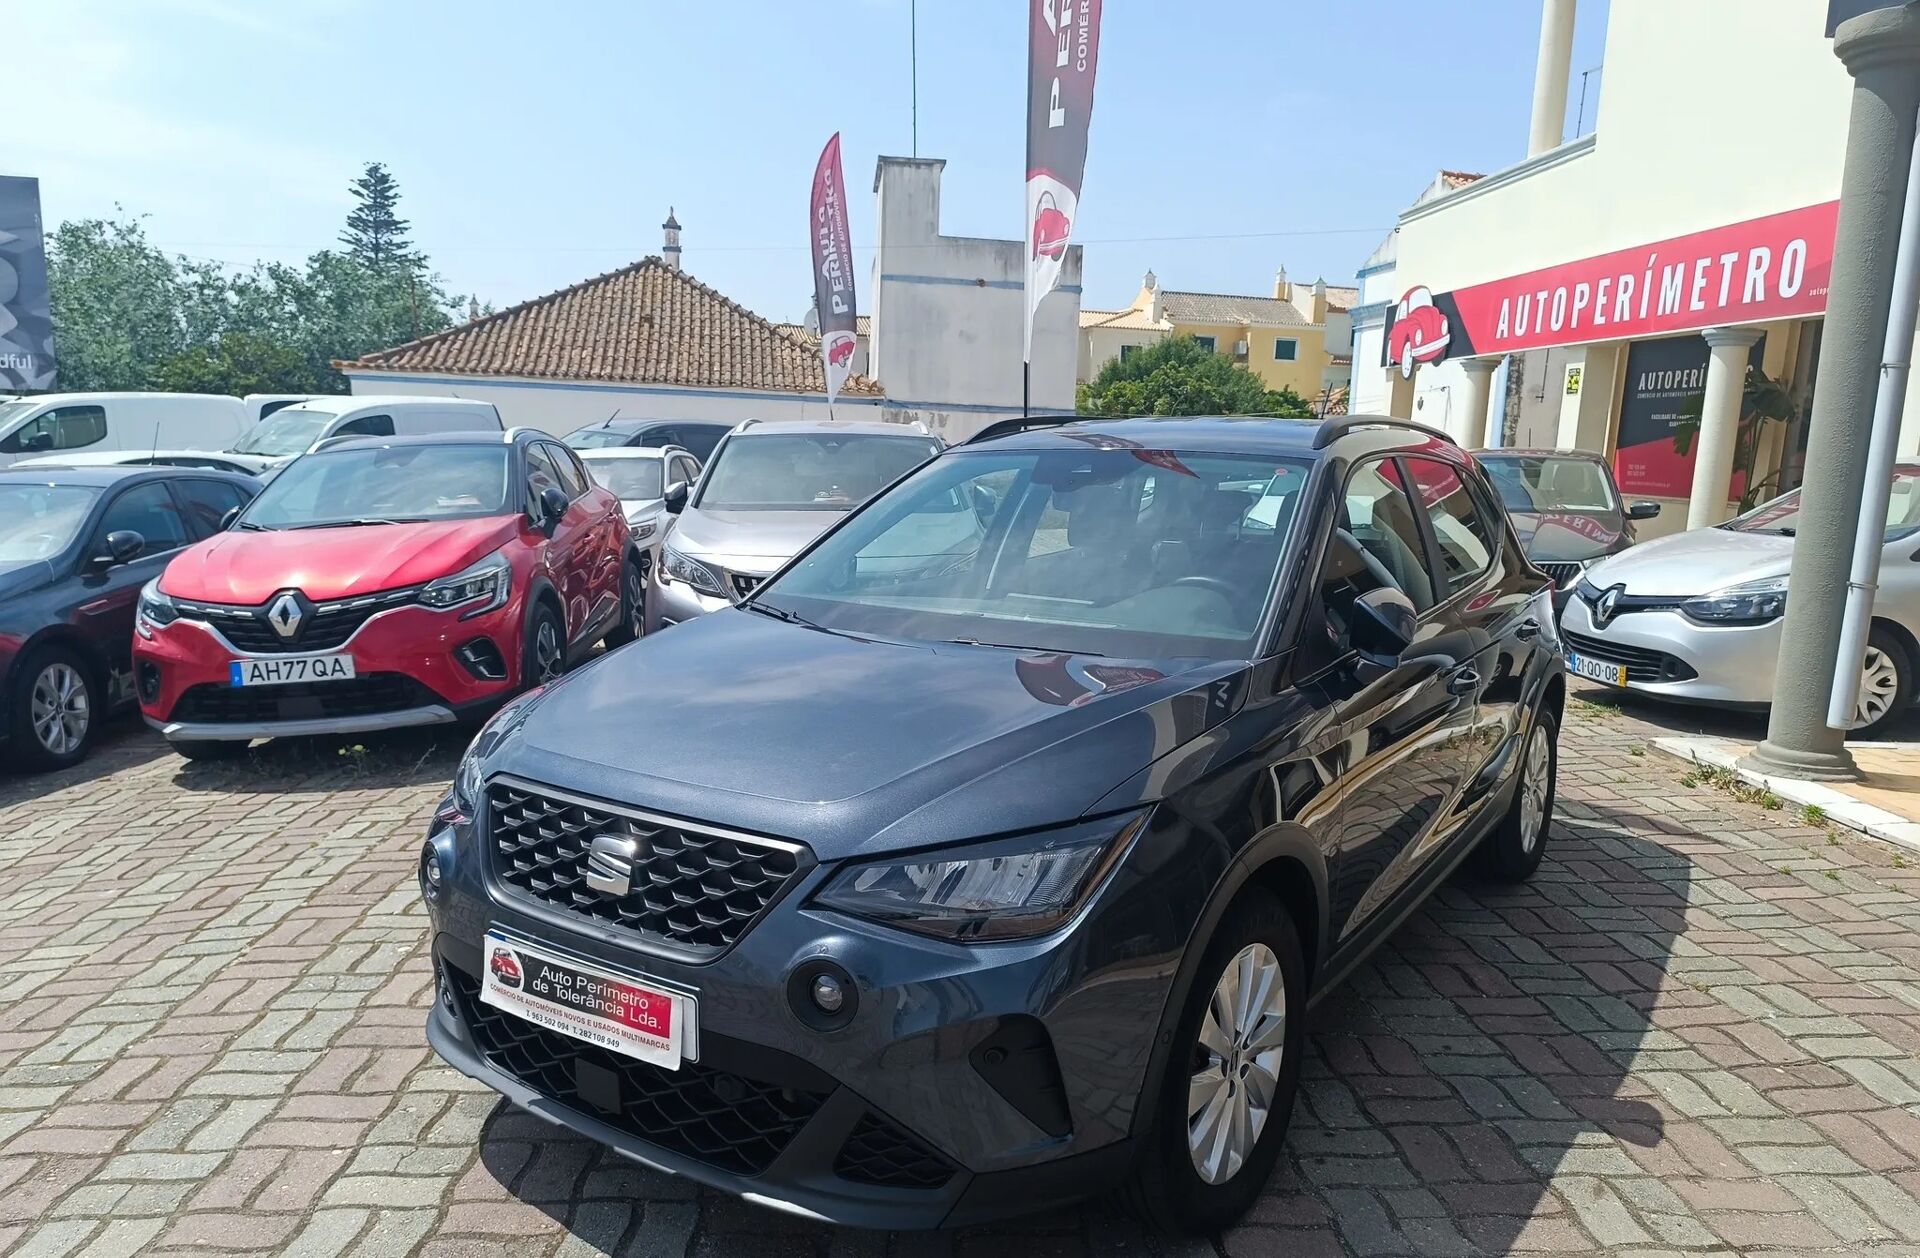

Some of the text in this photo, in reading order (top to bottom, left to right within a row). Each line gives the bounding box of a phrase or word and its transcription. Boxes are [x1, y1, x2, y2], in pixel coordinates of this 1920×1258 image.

[1495, 238, 1809, 340] AUTOPERÍMETRO
[1638, 363, 1706, 391] AUTOPERÍ
[532, 978, 662, 1030] de Tolerância Lda.
[540, 965, 650, 1010] Auto Perímetro
[516, 993, 525, 1004] DE
[524, 996, 564, 1018] AUTOMÓVEIS
[563, 1009, 586, 1025] NOVOS
[586, 1018, 592, 1026] E
[592, 1020, 621, 1036] USADOS
[620, 1028, 671, 1052] MULTIMARCAS
[531, 1012, 543, 1023] 963
[543, 1015, 556, 1028] 502
[556, 1019, 569, 1032] 094
[579, 1027, 592, 1039] 282
[592, 1032, 606, 1044] 108
[606, 1036, 621, 1049] 949
